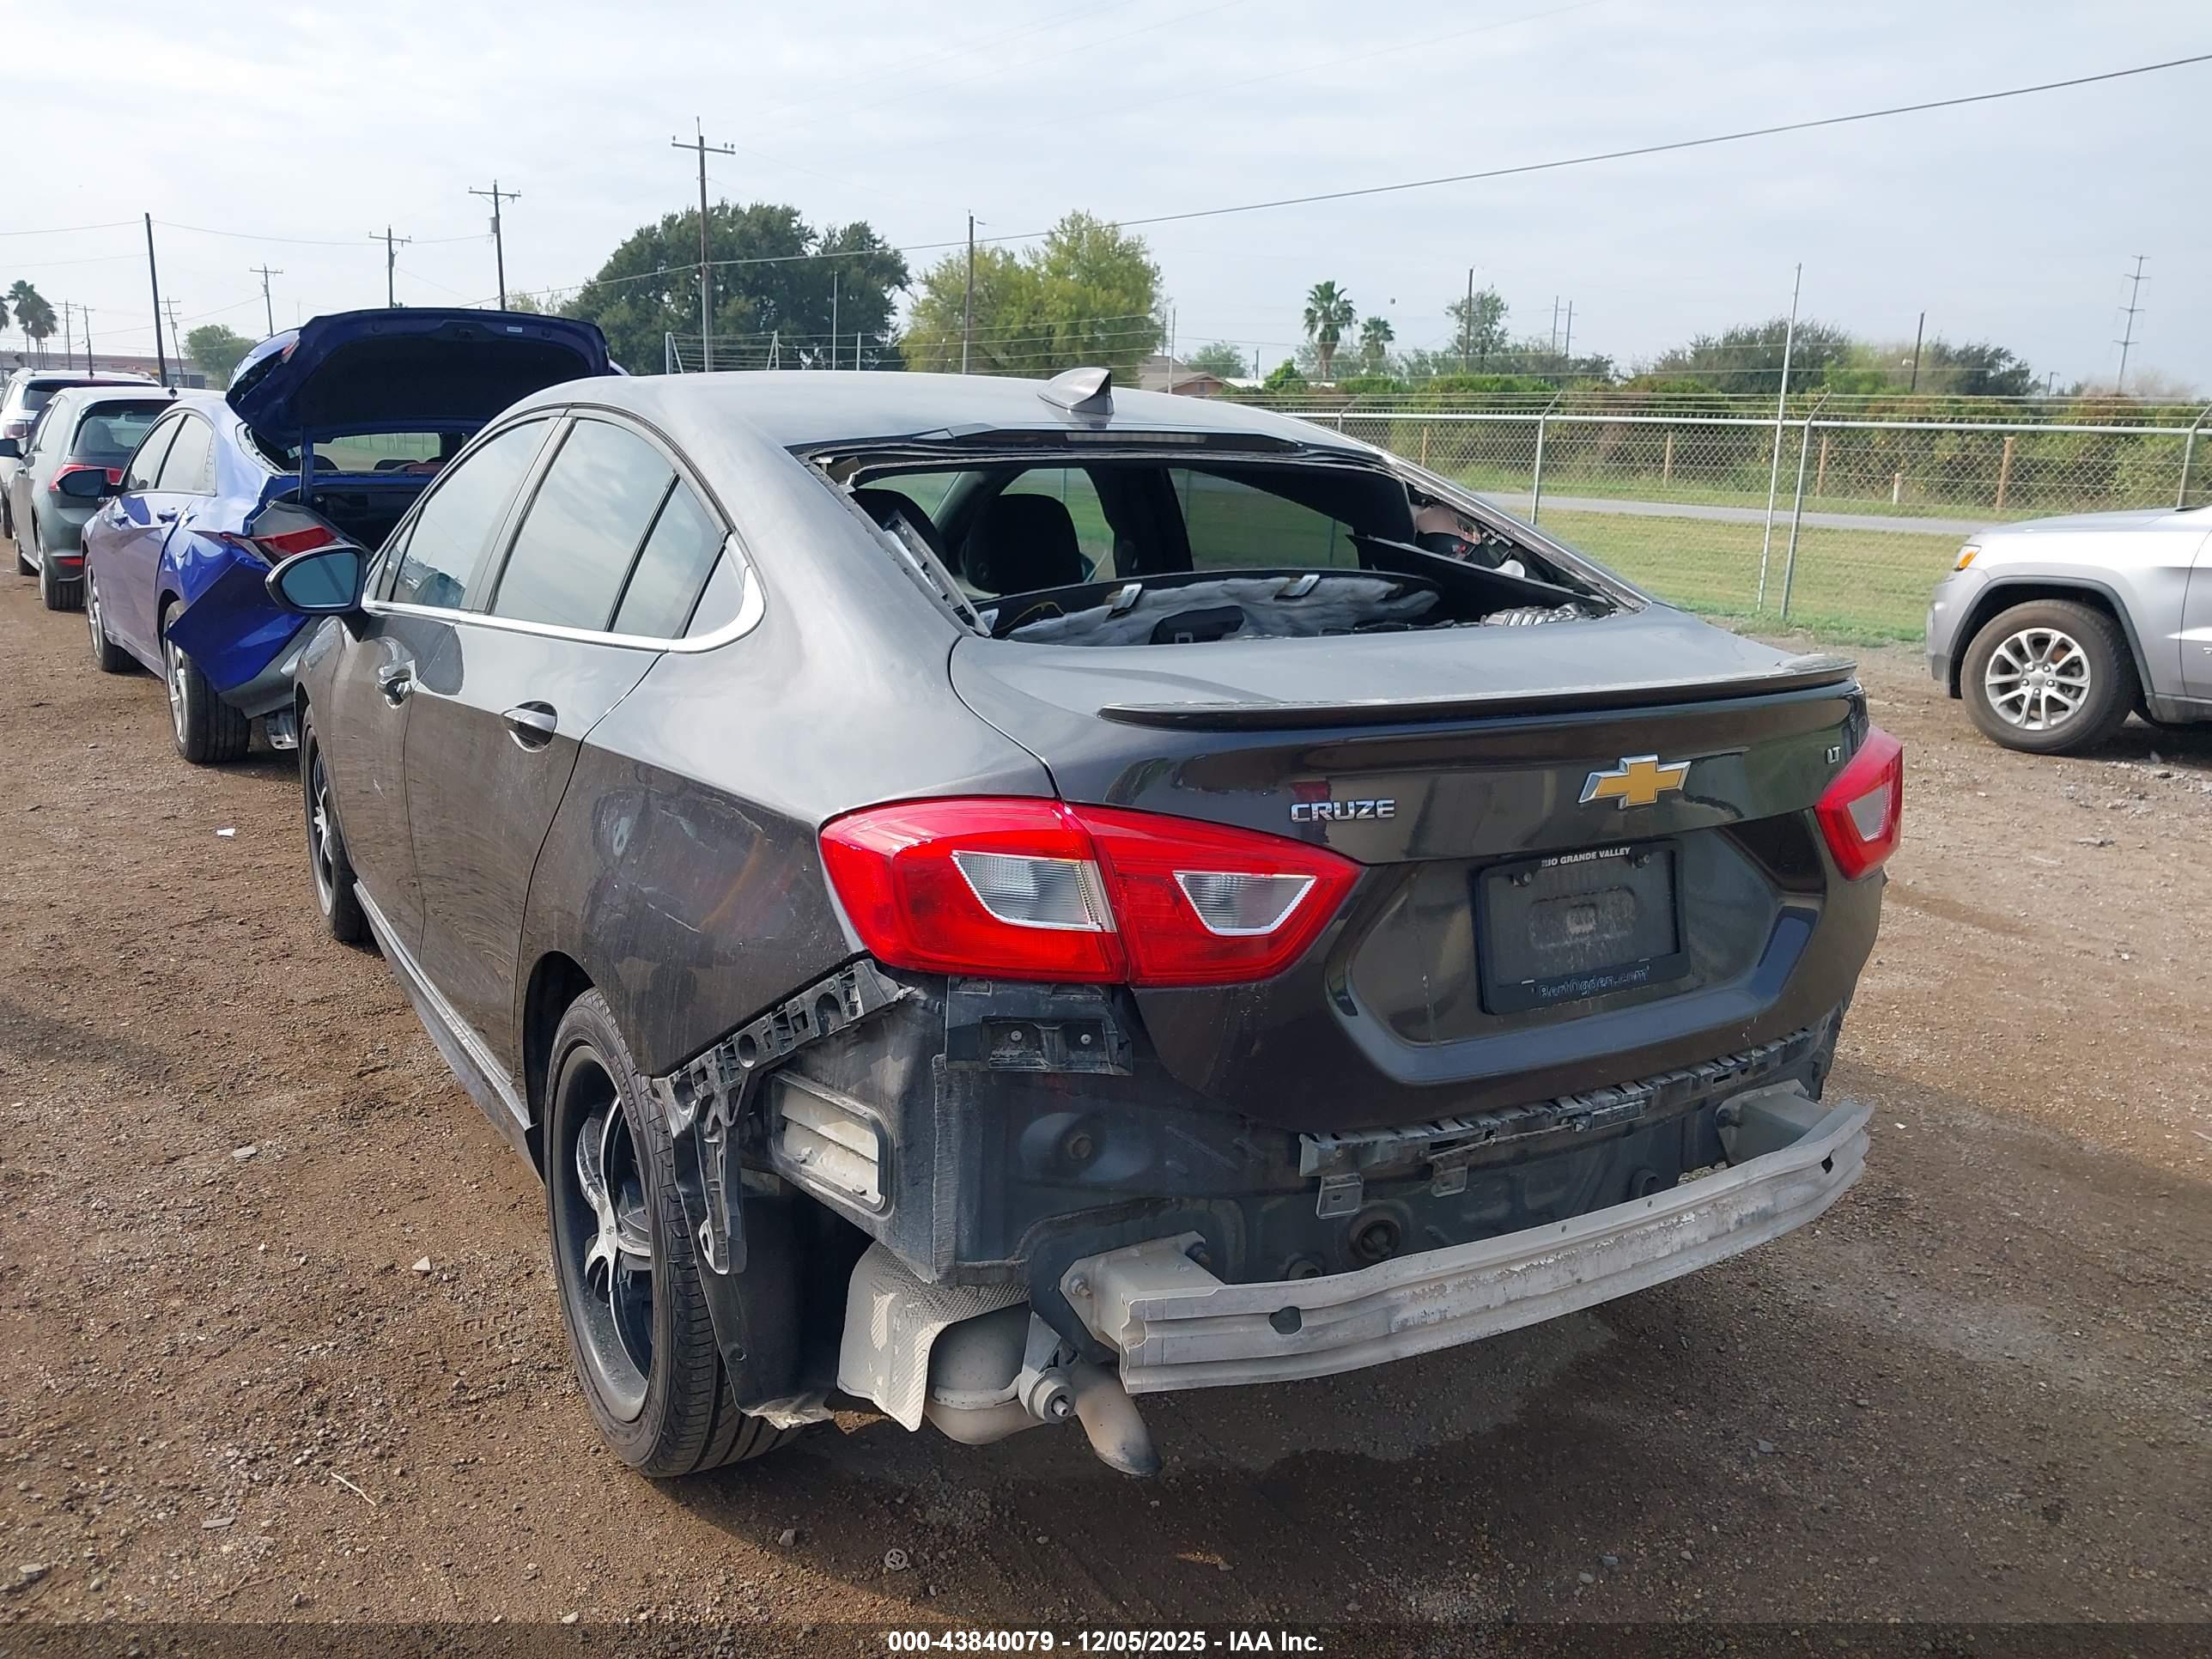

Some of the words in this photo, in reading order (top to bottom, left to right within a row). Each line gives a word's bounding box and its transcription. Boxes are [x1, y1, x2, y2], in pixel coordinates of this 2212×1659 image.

[1826, 745, 1841, 764] LT
[1290, 798, 1396, 823] CRUZE
[1559, 851, 1597, 865] GRANDE
[1599, 847, 1631, 859] VALLEY
